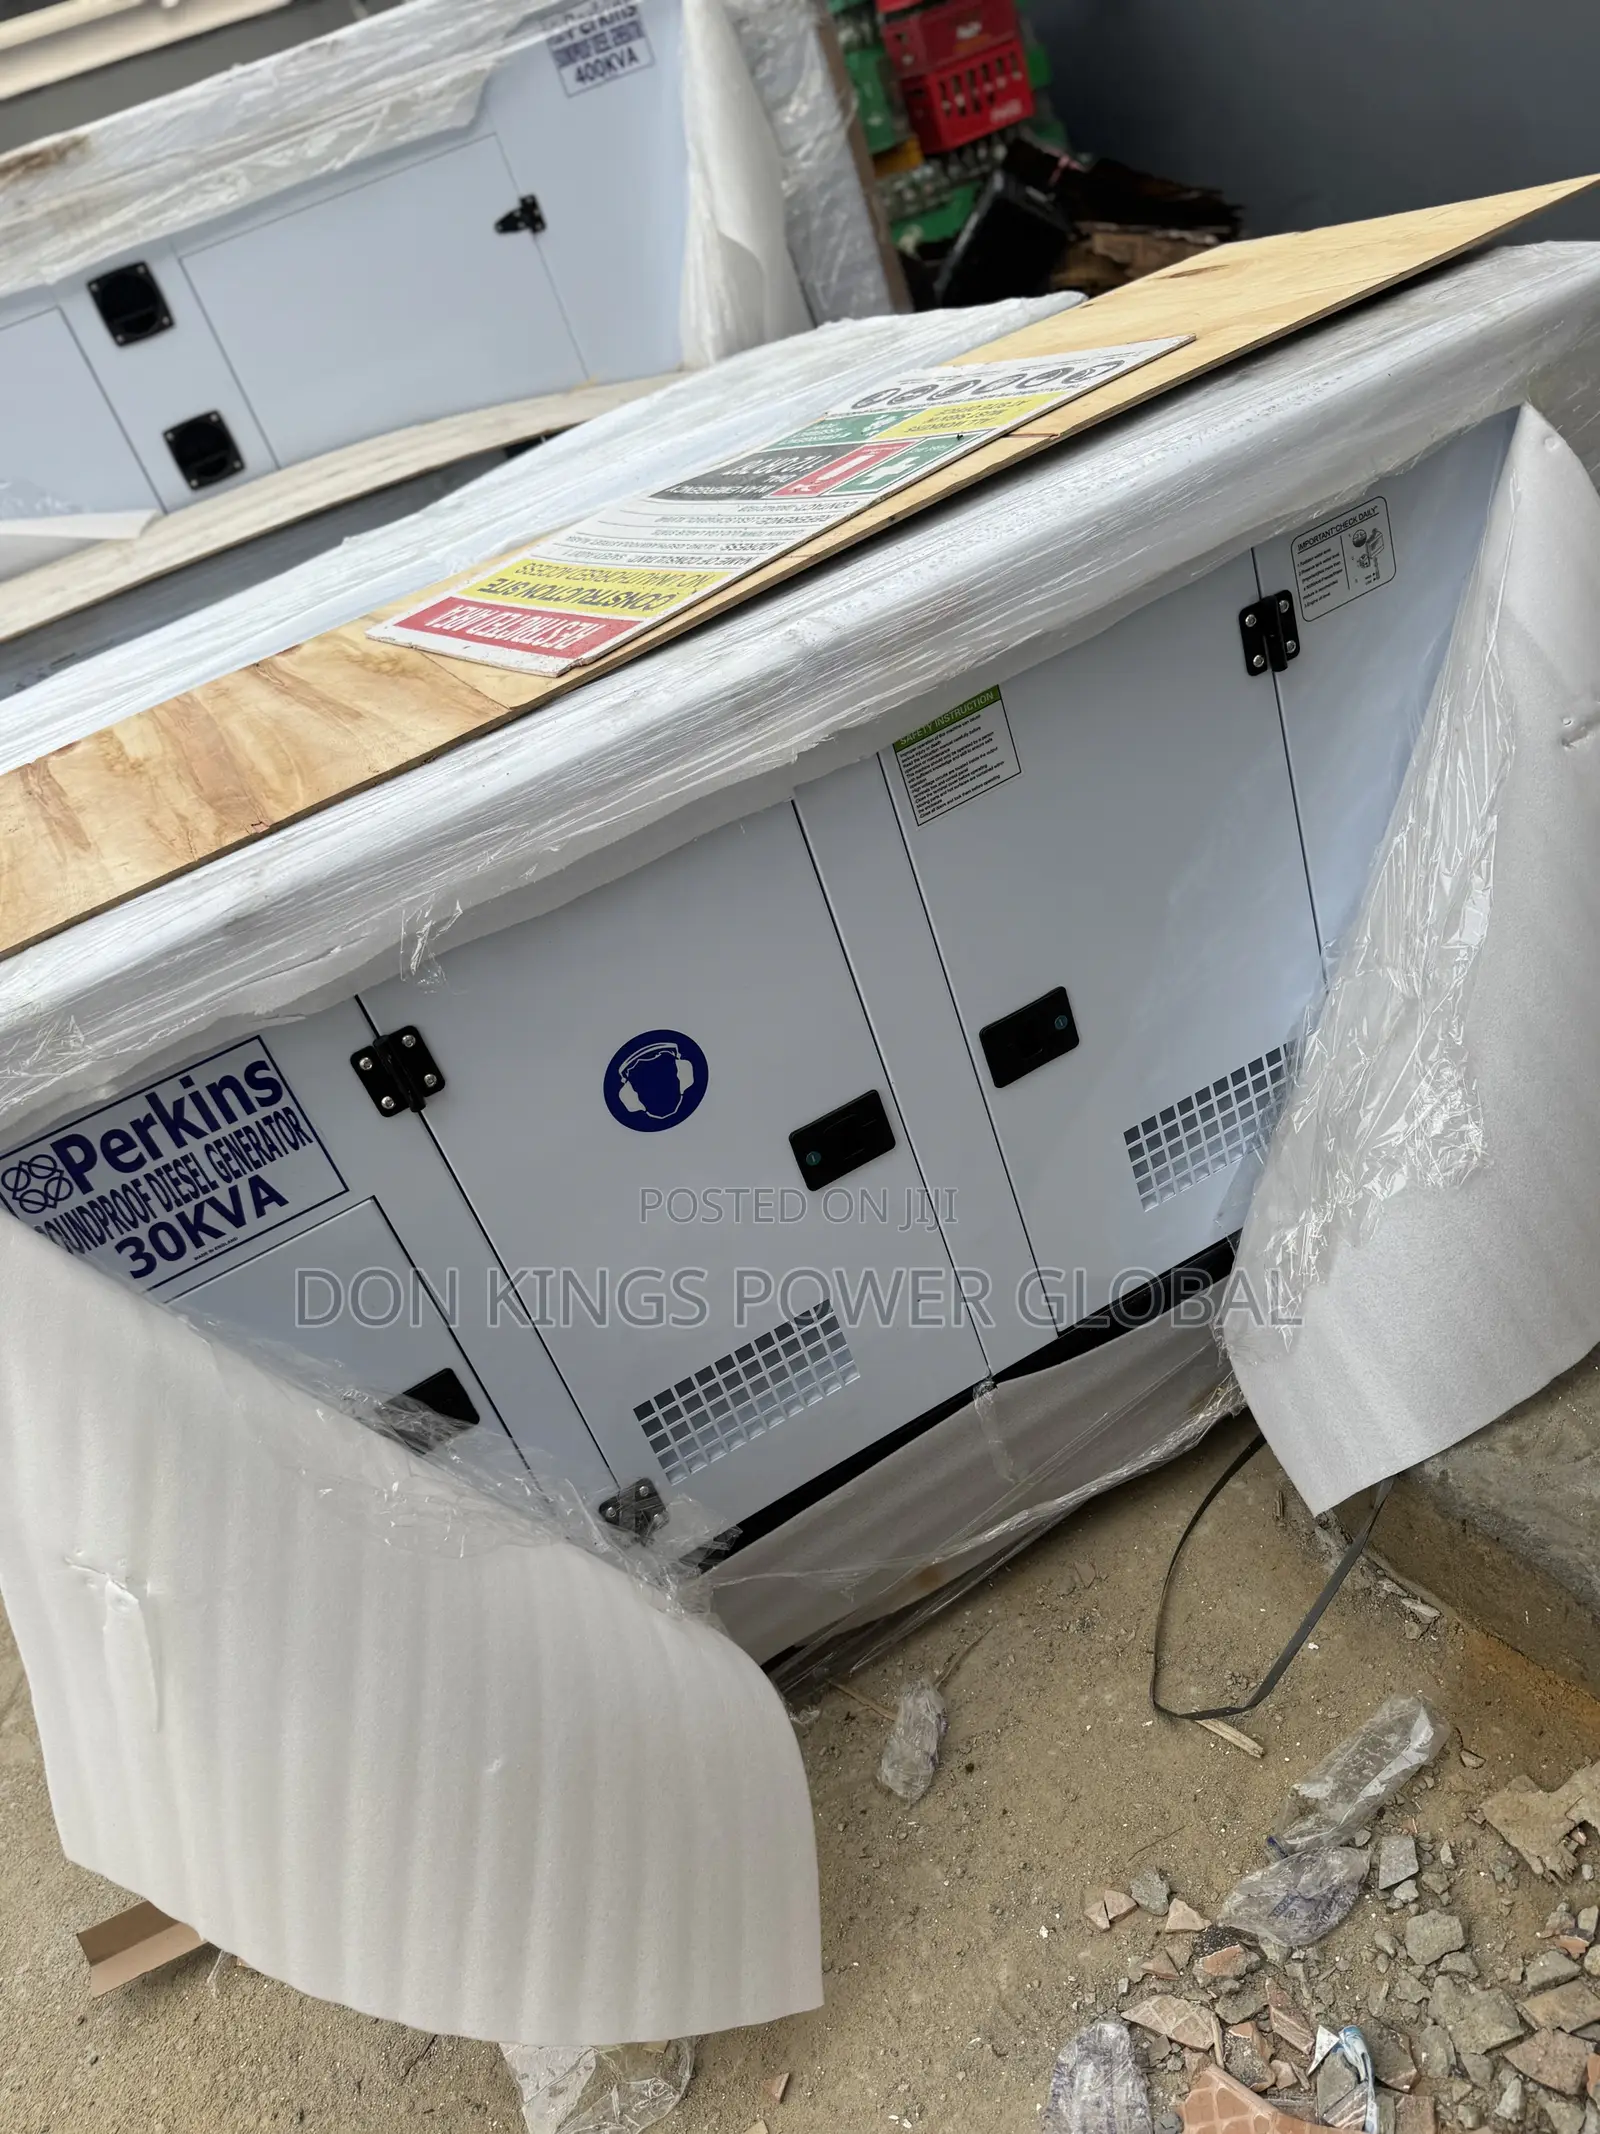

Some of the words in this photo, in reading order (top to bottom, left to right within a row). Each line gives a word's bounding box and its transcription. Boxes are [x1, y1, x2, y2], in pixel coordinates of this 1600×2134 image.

[576, 46, 639, 84] 400KVA
[746, 456, 805, 474] OR
[776, 454, 837, 472] 112
[510, 562, 581, 578] ACCESS
[712, 556, 759, 565] NAME
[474, 577, 535, 595] SITE
[561, 568, 690, 586] UNAUTHORISED
[671, 574, 718, 587] NO
[512, 583, 681, 612] CONSTRUCTION
[421, 604, 500, 631] AREA
[463, 611, 608, 649] RESTRICTED
[899, 722, 932, 745] SAFETY
[934, 690, 993, 727] INSTRUCTION
[50, 1060, 284, 1195] Perkins
[143, 1152, 218, 1213] DIESEL
[204, 1106, 314, 1184] GENERATOR
[114, 1174, 290, 1280] 30KVA
